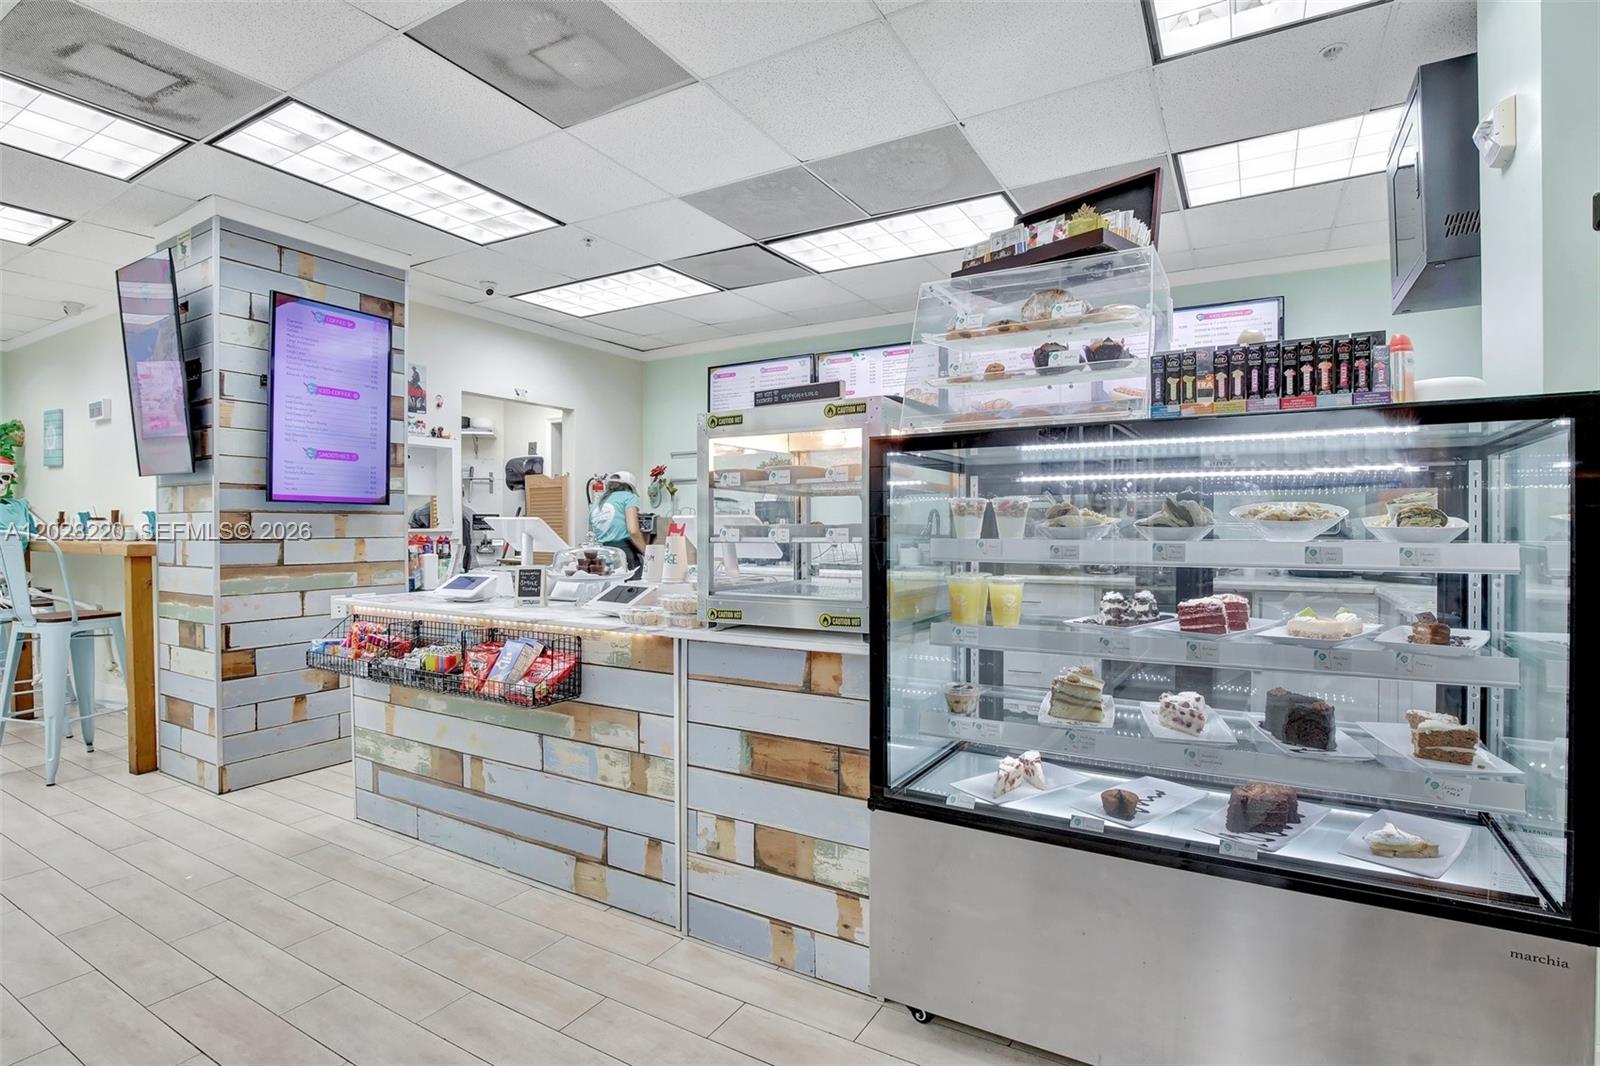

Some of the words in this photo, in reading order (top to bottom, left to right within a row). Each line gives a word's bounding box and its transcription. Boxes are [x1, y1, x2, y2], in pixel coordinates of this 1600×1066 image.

[837, 406, 856, 414] CAUTION
[857, 404, 866, 413] HOT
[718, 417, 734, 425] CAUTION
[734, 416, 742, 424] HOT
[832, 617, 851, 626] CAUTION
[1510, 951, 1569, 969] marchia
